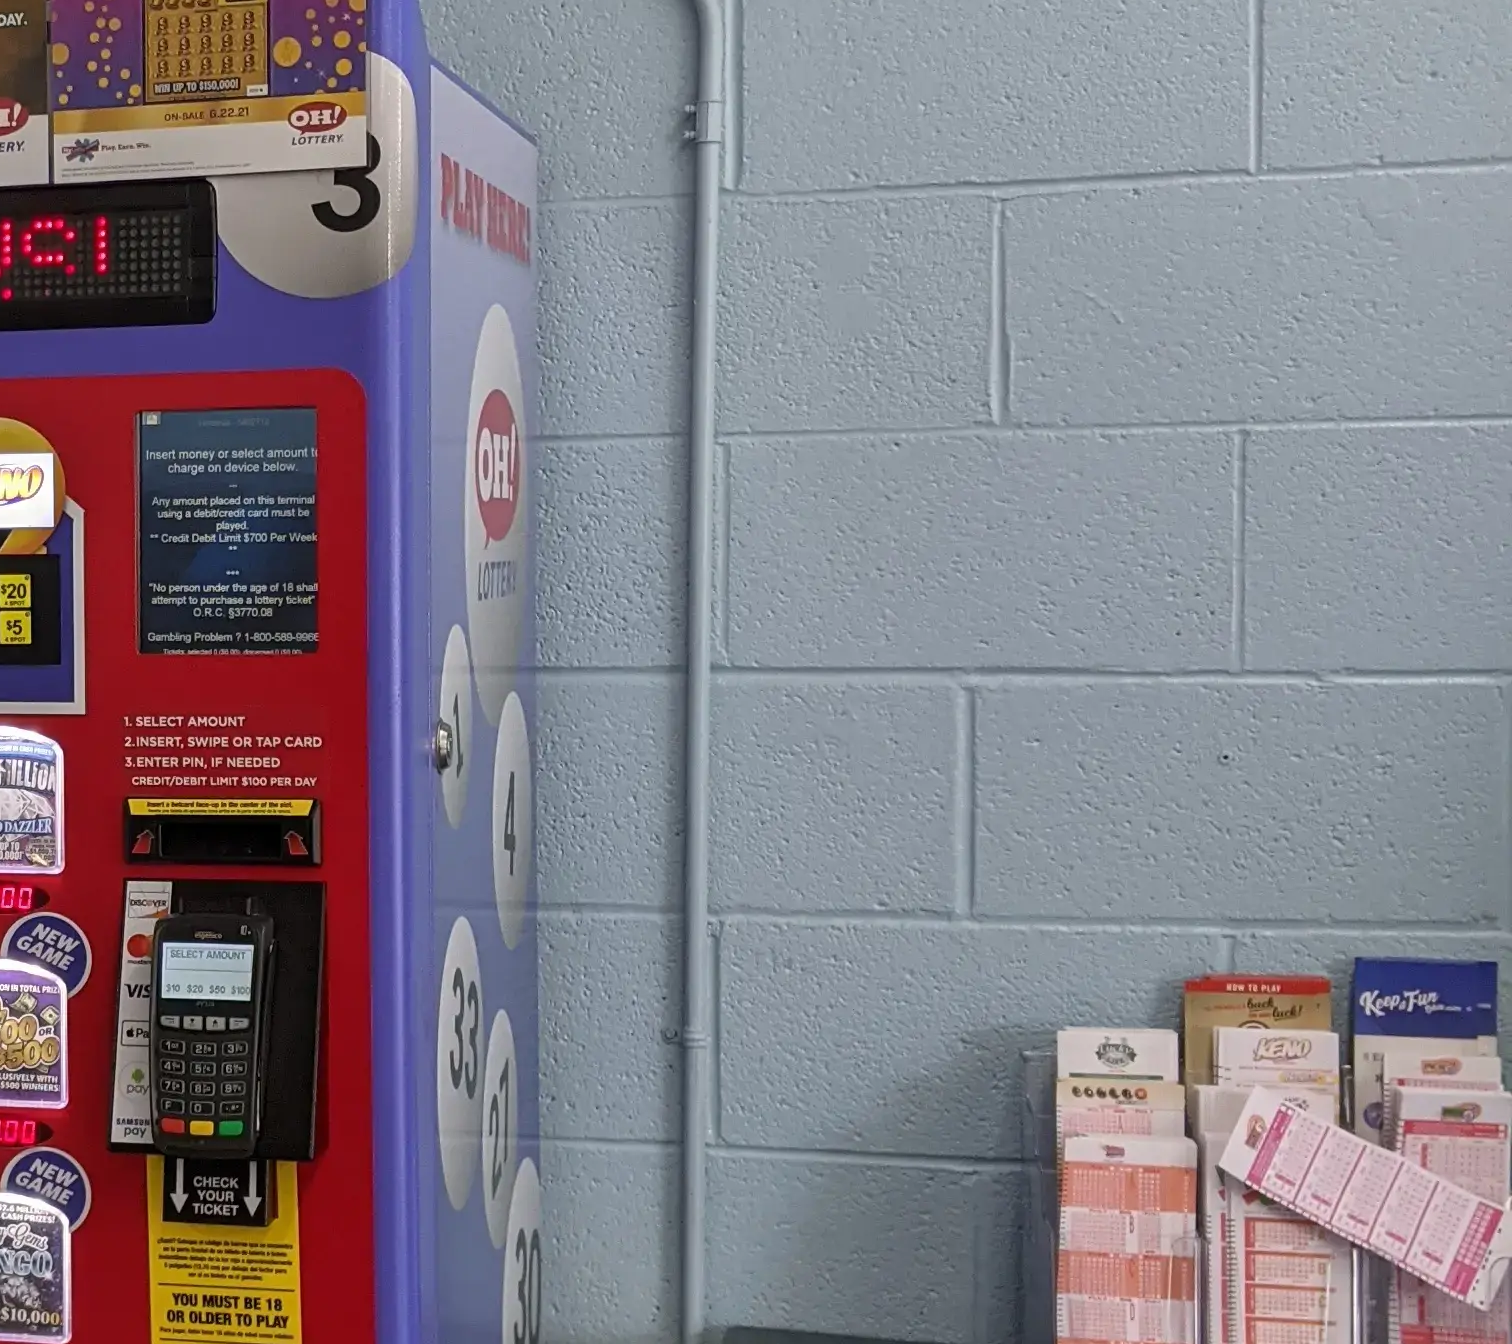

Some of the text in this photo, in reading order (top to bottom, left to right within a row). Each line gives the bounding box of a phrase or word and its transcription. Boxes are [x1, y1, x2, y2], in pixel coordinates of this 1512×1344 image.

[310, 131, 381, 232] 3
[440, 151, 532, 266] PLAY HERE!
[168, 461, 298, 475] charge on device below.
[478, 423, 517, 502] OH!
[161, 533, 317, 542] Credit Debit Limit $700 Per Week
[124, 716, 245, 726] 1. SELECT AMOUNT
[132, 776, 317, 787] CREDIT/DEBIT LIMIT $100 PER DAY
[32, 922, 81, 952] NEW
[15, 936, 78, 971] GAME
[170, 949, 246, 960] SELECT AMOUNT
[1226, 983, 1280, 993] HOW TO PLAY
[1359, 990, 1438, 1017] Keep Fun
[449, 965, 479, 1100] 33
[1253, 1037, 1312, 1060] KENO
[193, 1176, 239, 1189] CHECK
[197, 1190, 235, 1202] YOUR
[192, 1203, 239, 1216] TICKET
[172, 1293, 282, 1311] YOU MUST BE 18
[167, 1310, 289, 1329] OR OLDER TO PLAY
